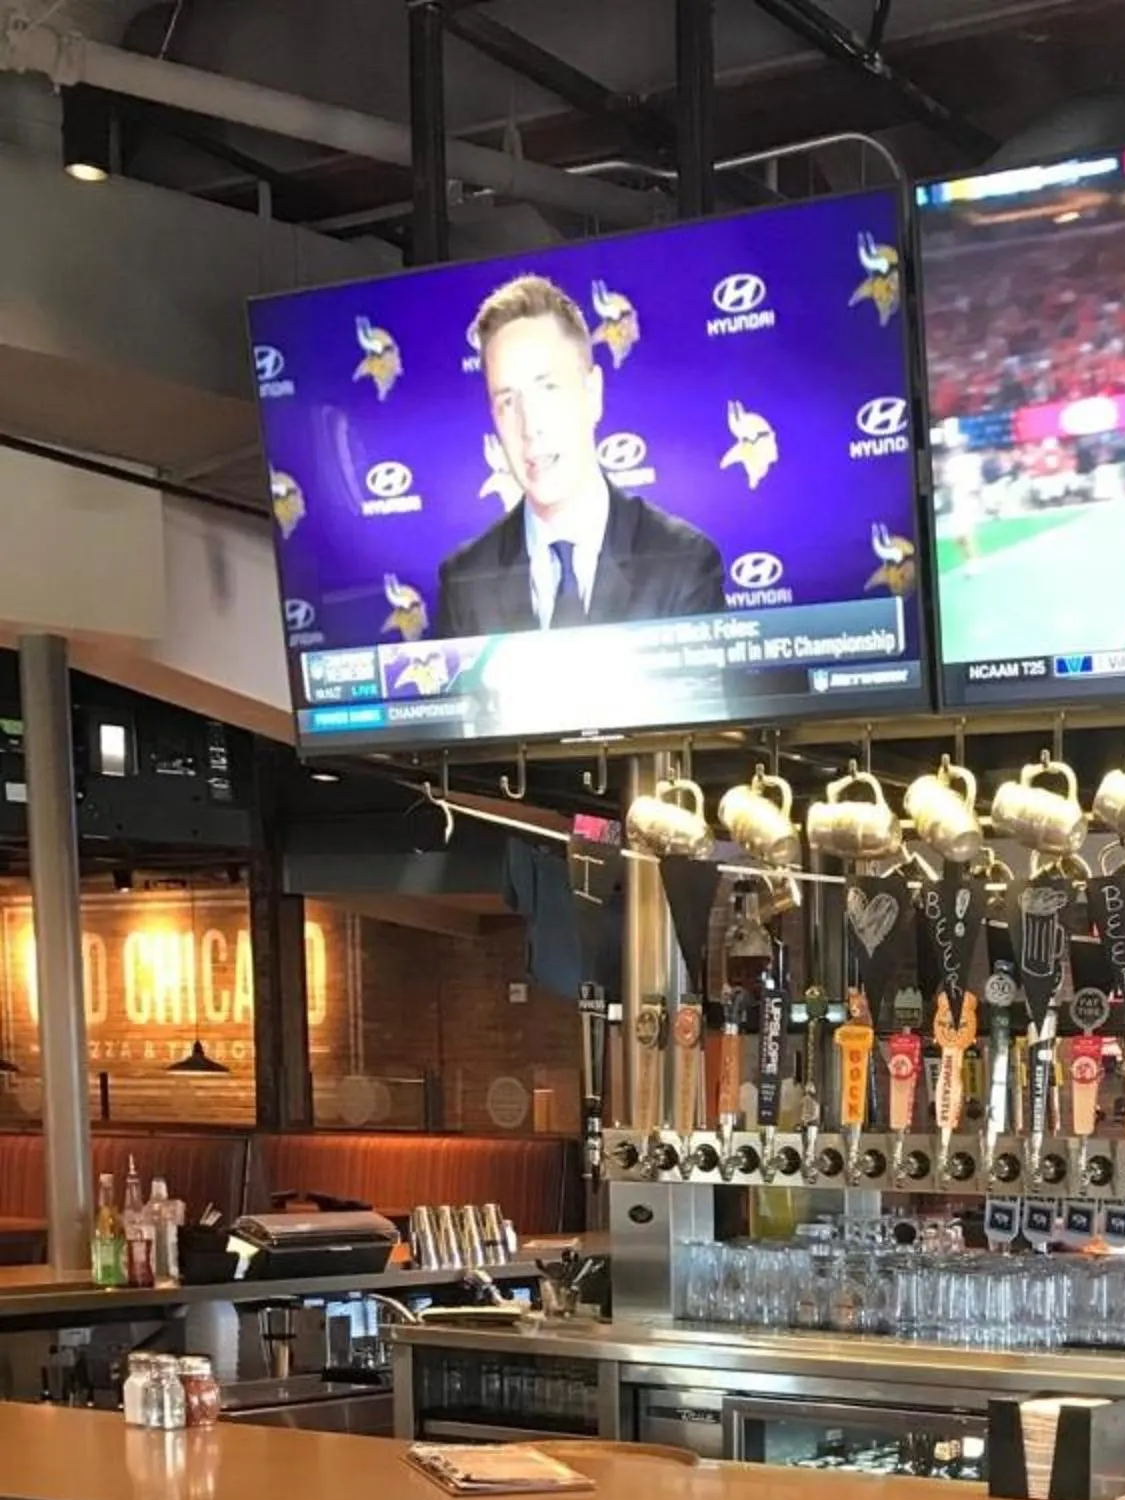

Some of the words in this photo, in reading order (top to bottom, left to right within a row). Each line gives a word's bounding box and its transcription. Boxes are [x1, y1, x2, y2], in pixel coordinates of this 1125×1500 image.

[707, 310, 776, 336] HYUNDAI
[849, 435, 909, 458] HYUND
[725, 587, 793, 609] HYUNDAI
[794, 630, 896, 658] Championship
[969, 662, 1020, 681] NCAAM
[1022, 660, 1046, 678] T25
[122, 921, 327, 1026] CHICAO
[766, 997, 782, 1075] UPSLOPE
[847, 1050, 862, 1118] BOCK
[940, 1055, 953, 1122] NEWCASTLE
